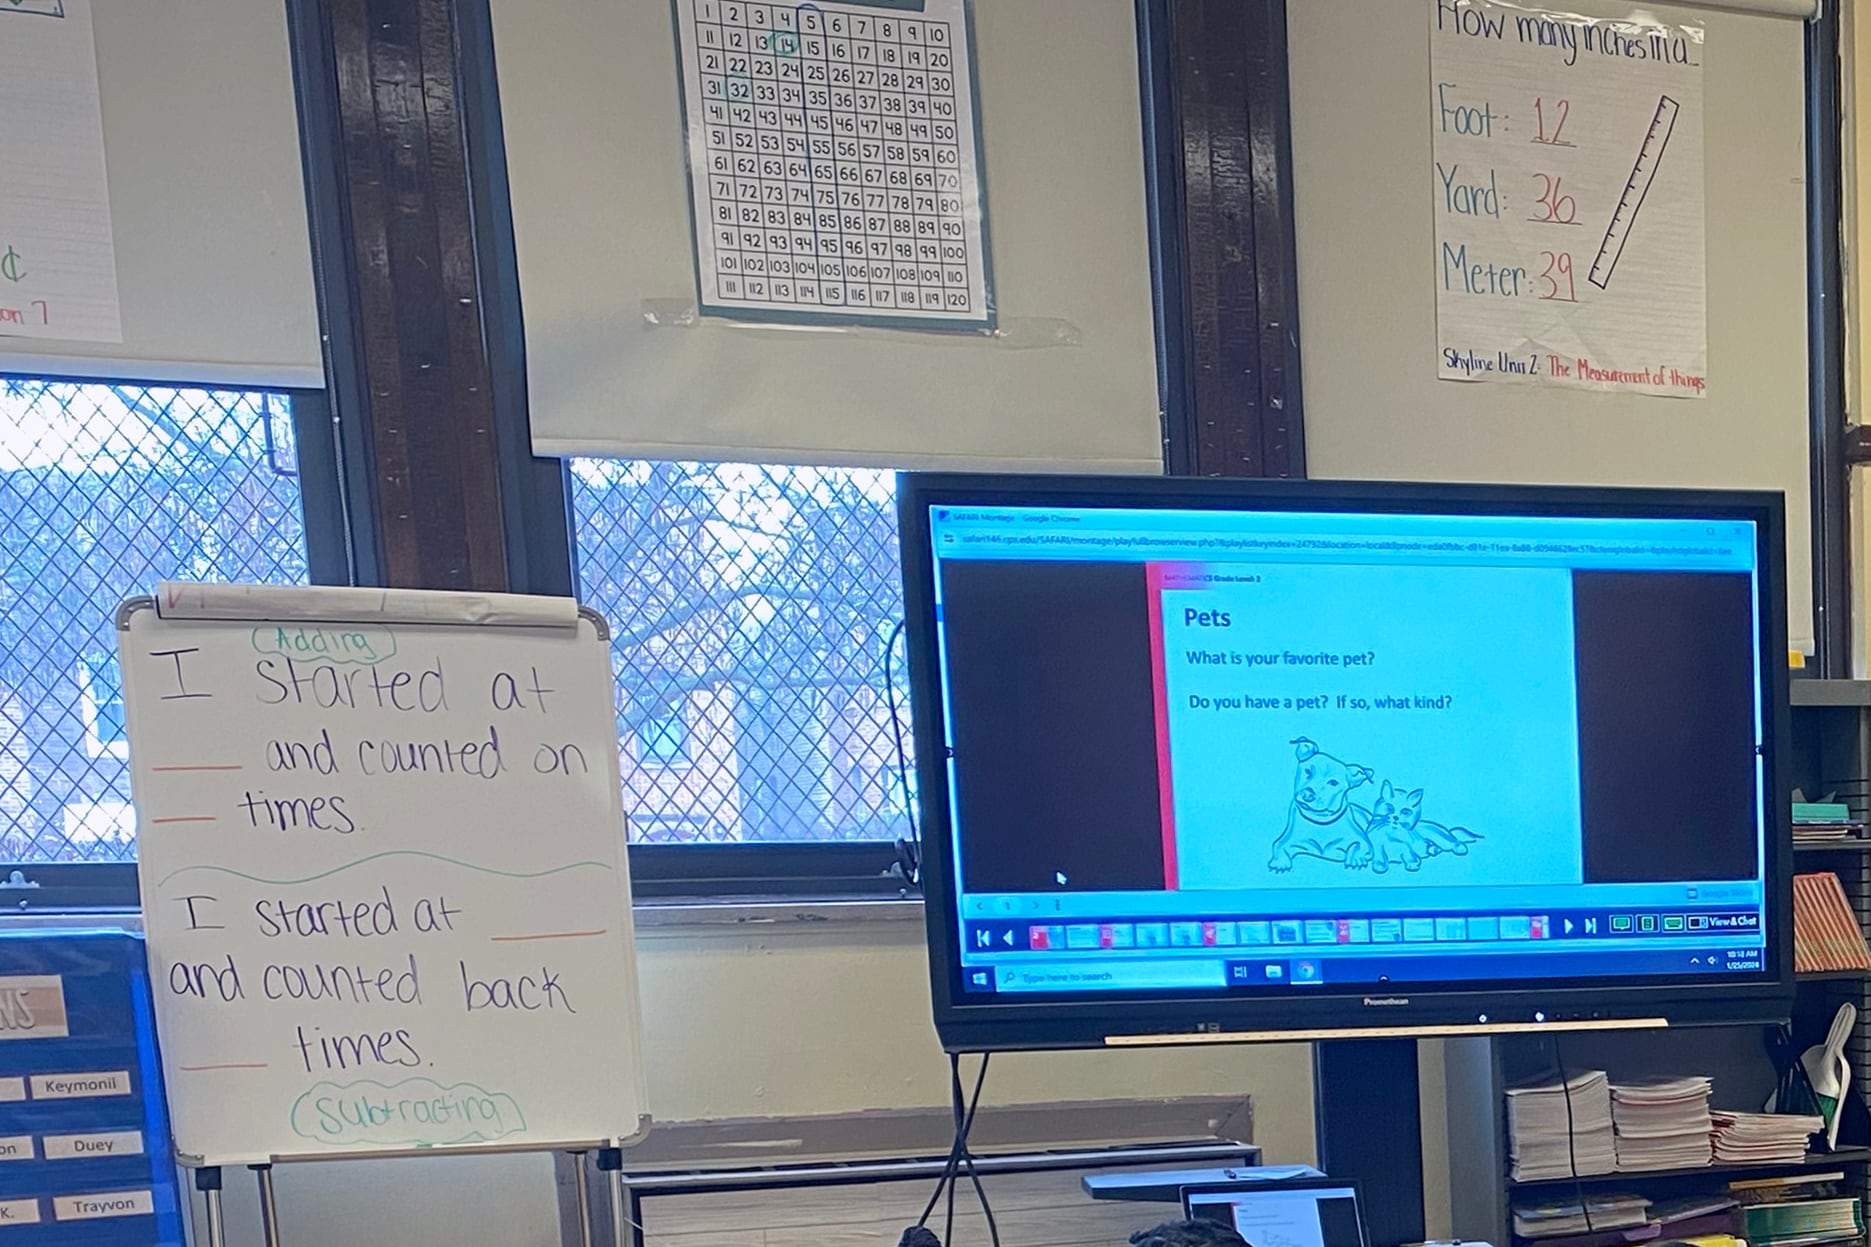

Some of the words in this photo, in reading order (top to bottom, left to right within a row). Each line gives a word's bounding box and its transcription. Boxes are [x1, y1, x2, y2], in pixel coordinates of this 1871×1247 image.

[807, 15, 816, 30] 5
[1438, 0, 1504, 39] How
[1516, 16, 1576, 66] many
[1438, 83, 1509, 138] Foot:
[1531, 97, 1572, 145] 12
[1436, 162, 1507, 219] Yard:
[1532, 173, 1577, 224] 36
[1443, 241, 1533, 298] Meter:
[1539, 250, 1576, 301] 39
[749, 283, 763, 295] 112
[774, 285, 789, 297] 113
[800, 286, 814, 298] 114
[825, 288, 839, 300] 115
[851, 289, 865, 301] 116
[875, 290, 889, 301] 117
[900, 292, 915, 303] 118
[925, 292, 939, 305] 119
[947, 293, 966, 306] 120
[1443, 347, 1493, 376] Skyline
[1547, 355, 1570, 377] The
[1577, 359, 1650, 384] Measurement
[1669, 367, 1705, 395] things
[1184, 607, 1232, 627] Pets
[275, 627, 372, 658] Adding
[1186, 651, 1227, 665] What
[1231, 651, 1243, 665] is
[1246, 653, 1280, 667] your
[1283, 651, 1339, 666] favorite
[1343, 652, 1376, 668] pet?
[149, 647, 213, 700] I
[491, 666, 556, 714] at
[1189, 694, 1210, 709] Do
[1213, 696, 1241, 711] you
[1245, 695, 1279, 709] have
[1283, 697, 1292, 709] a
[1296, 695, 1329, 711] pet?
[1337, 695, 1347, 709] If
[1350, 697, 1371, 711] so,
[1374, 696, 1411, 709] what
[1414, 696, 1452, 709] kind?
[265, 729, 339, 777] and
[358, 725, 506, 780] counted
[533, 742, 589, 775] on
[237, 791, 367, 834] times.
[186, 896, 225, 932] I
[255, 886, 399, 937] started
[414, 896, 463, 933] at
[1710, 917, 1730, 926] View
[1738, 916, 1756, 925] Chat
[168, 954, 244, 1002] and
[263, 954, 421, 1005] counted
[460, 961, 577, 1015] back
[1080, 970, 1112, 982] search
[292, 1025, 435, 1073] times.
[45, 1077, 117, 1093] Keymonil
[318, 1095, 500, 1135] Subtracting
[74, 1139, 113, 1152] Duey
[73, 1199, 135, 1215] Trayvon
